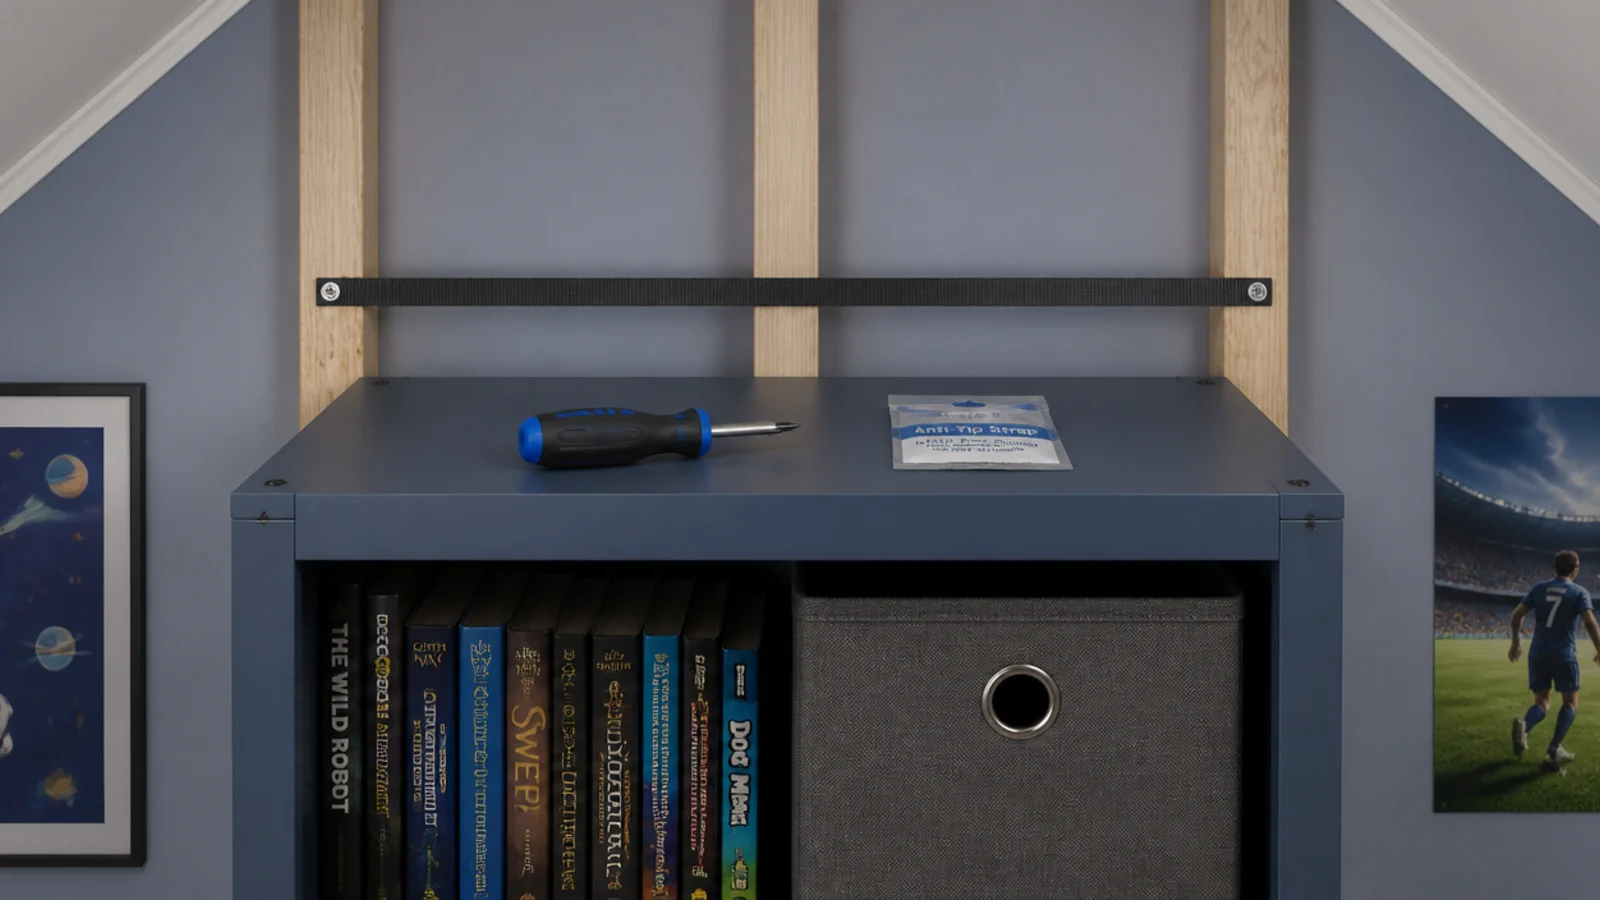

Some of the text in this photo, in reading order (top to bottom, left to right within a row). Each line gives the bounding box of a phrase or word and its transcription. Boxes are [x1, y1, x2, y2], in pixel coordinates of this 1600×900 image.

[914, 425, 1039, 436] Anti-Tip Strap
[1546, 595, 1562, 628] 7
[331, 622, 350, 814] THE WILD ROBOT
